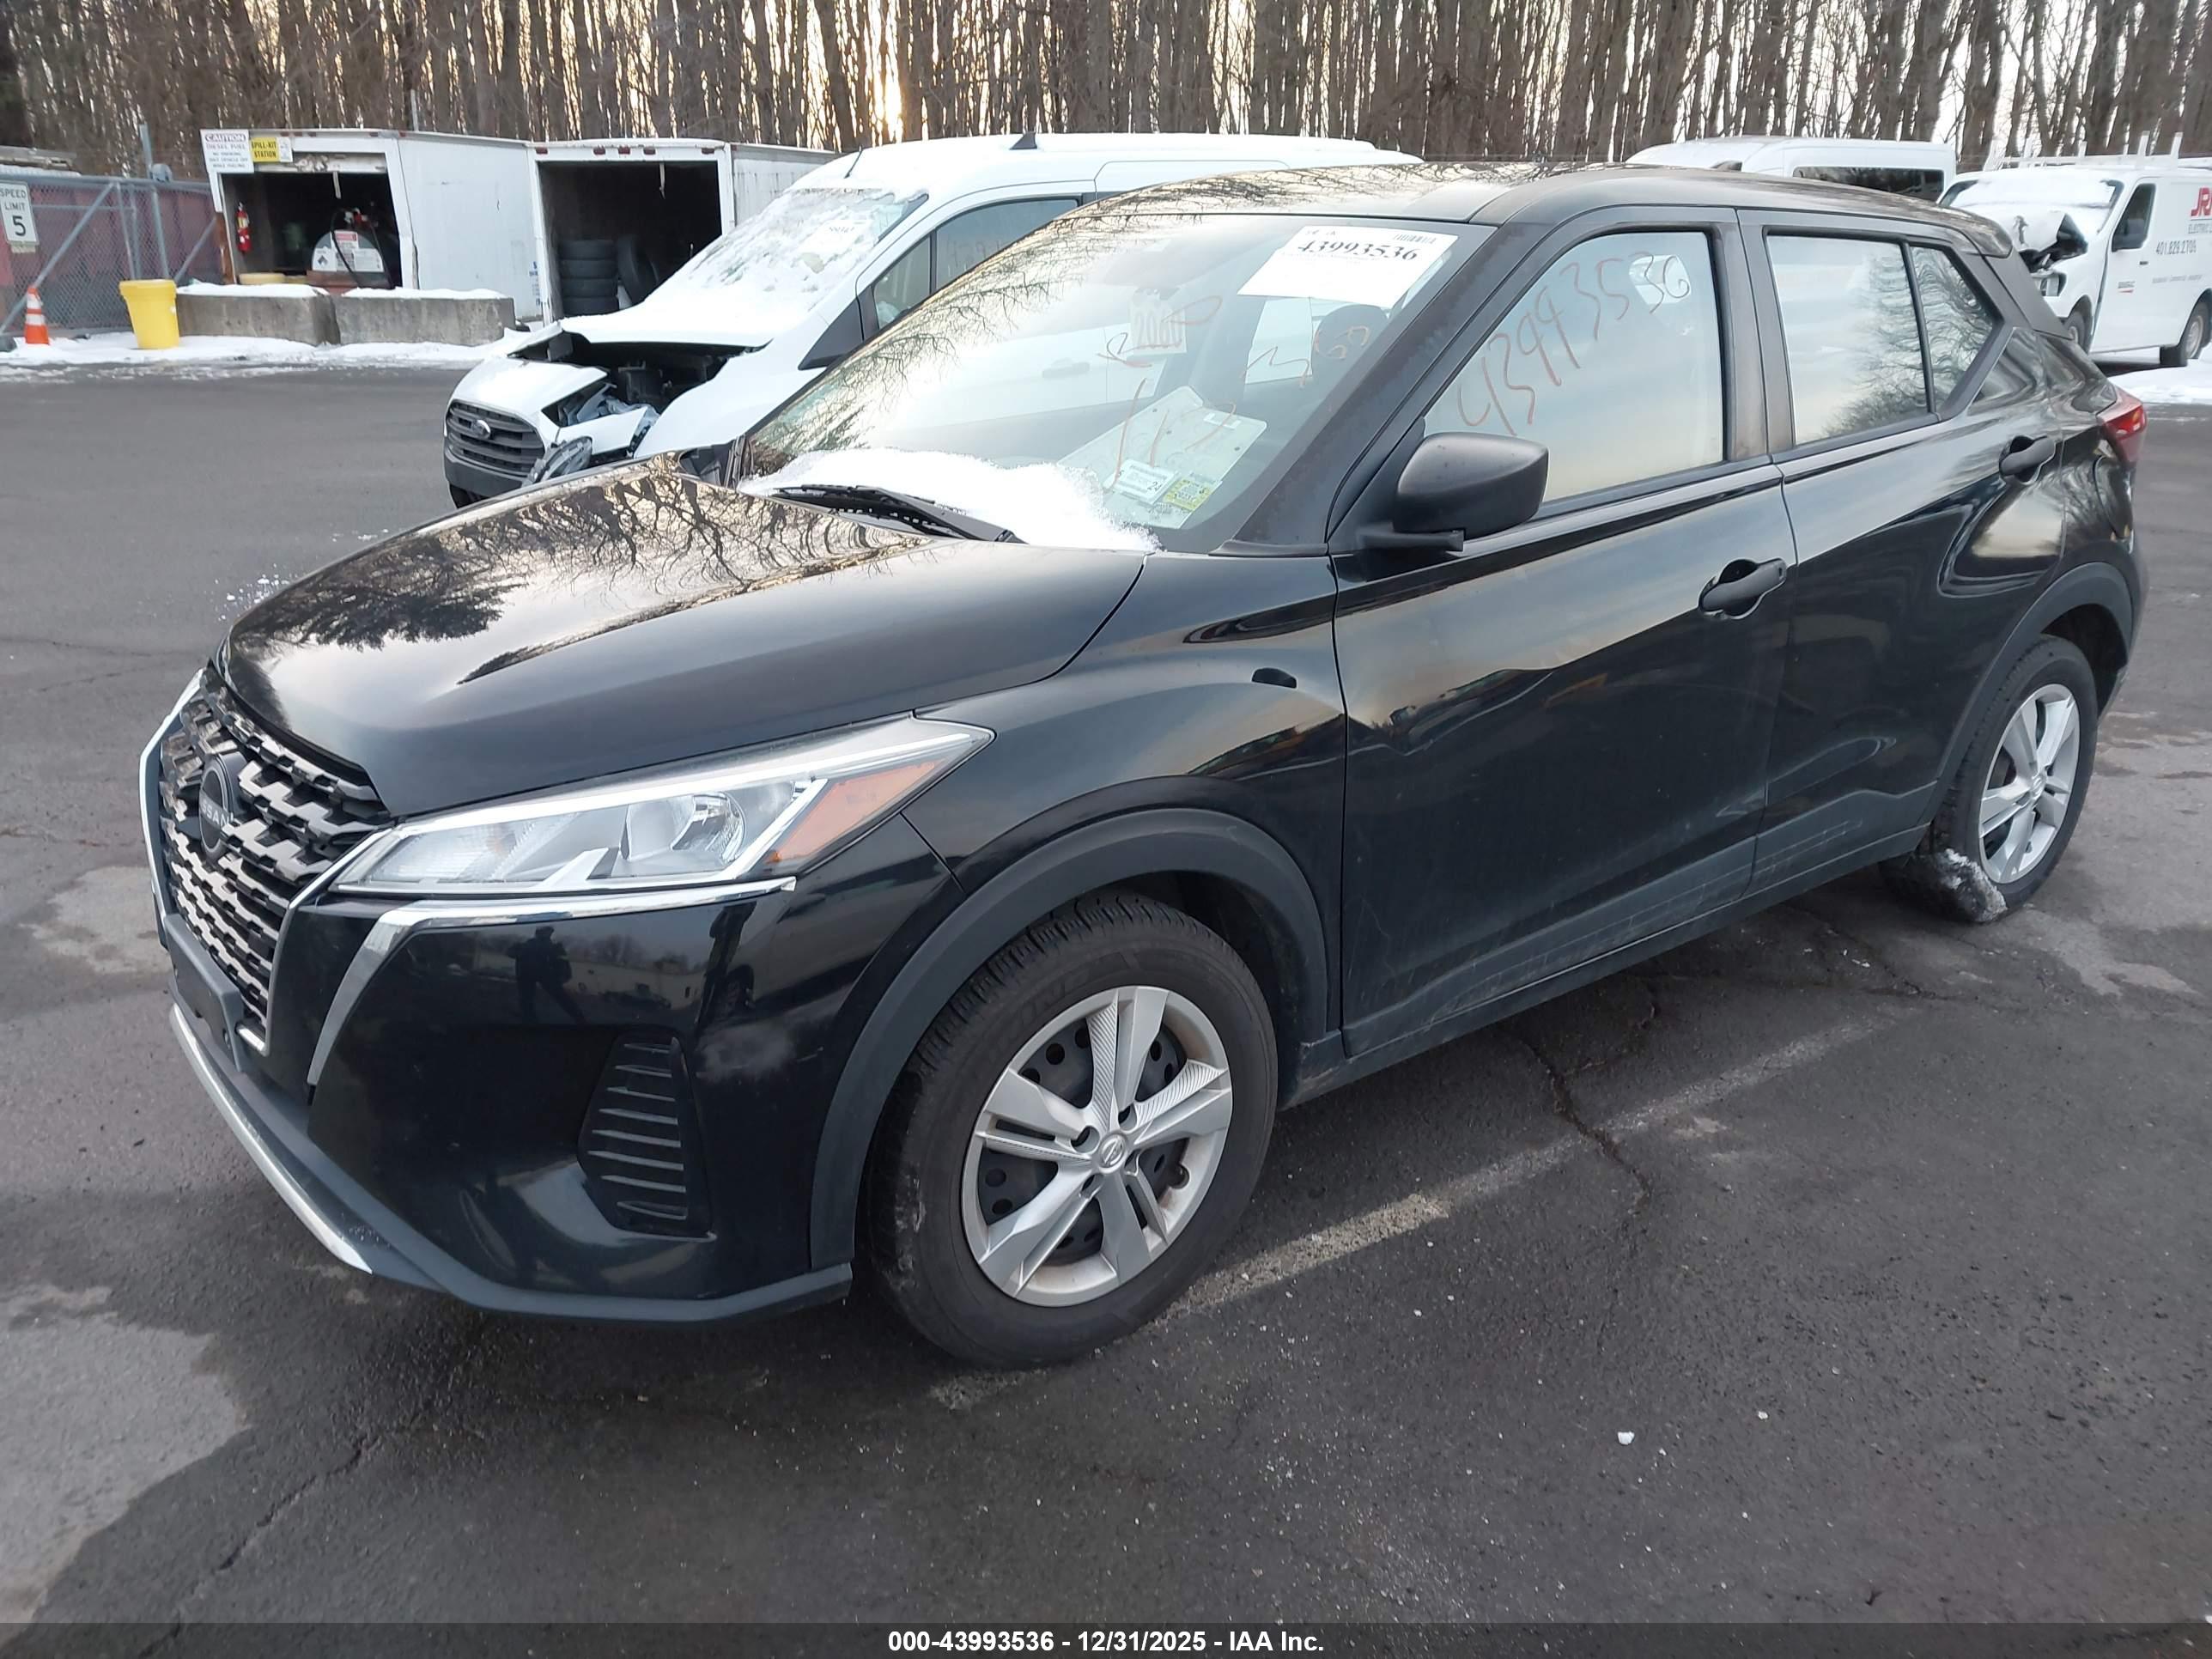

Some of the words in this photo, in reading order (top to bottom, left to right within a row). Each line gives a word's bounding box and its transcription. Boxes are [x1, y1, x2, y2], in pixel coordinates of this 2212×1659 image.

[205, 133, 246, 143] CAUTION
[254, 150, 276, 159] STATION
[0, 187, 27, 198] SPEED
[4, 201, 26, 211] LIMIT
[12, 215, 27, 236] 5
[1297, 240, 1420, 261] 43993536
